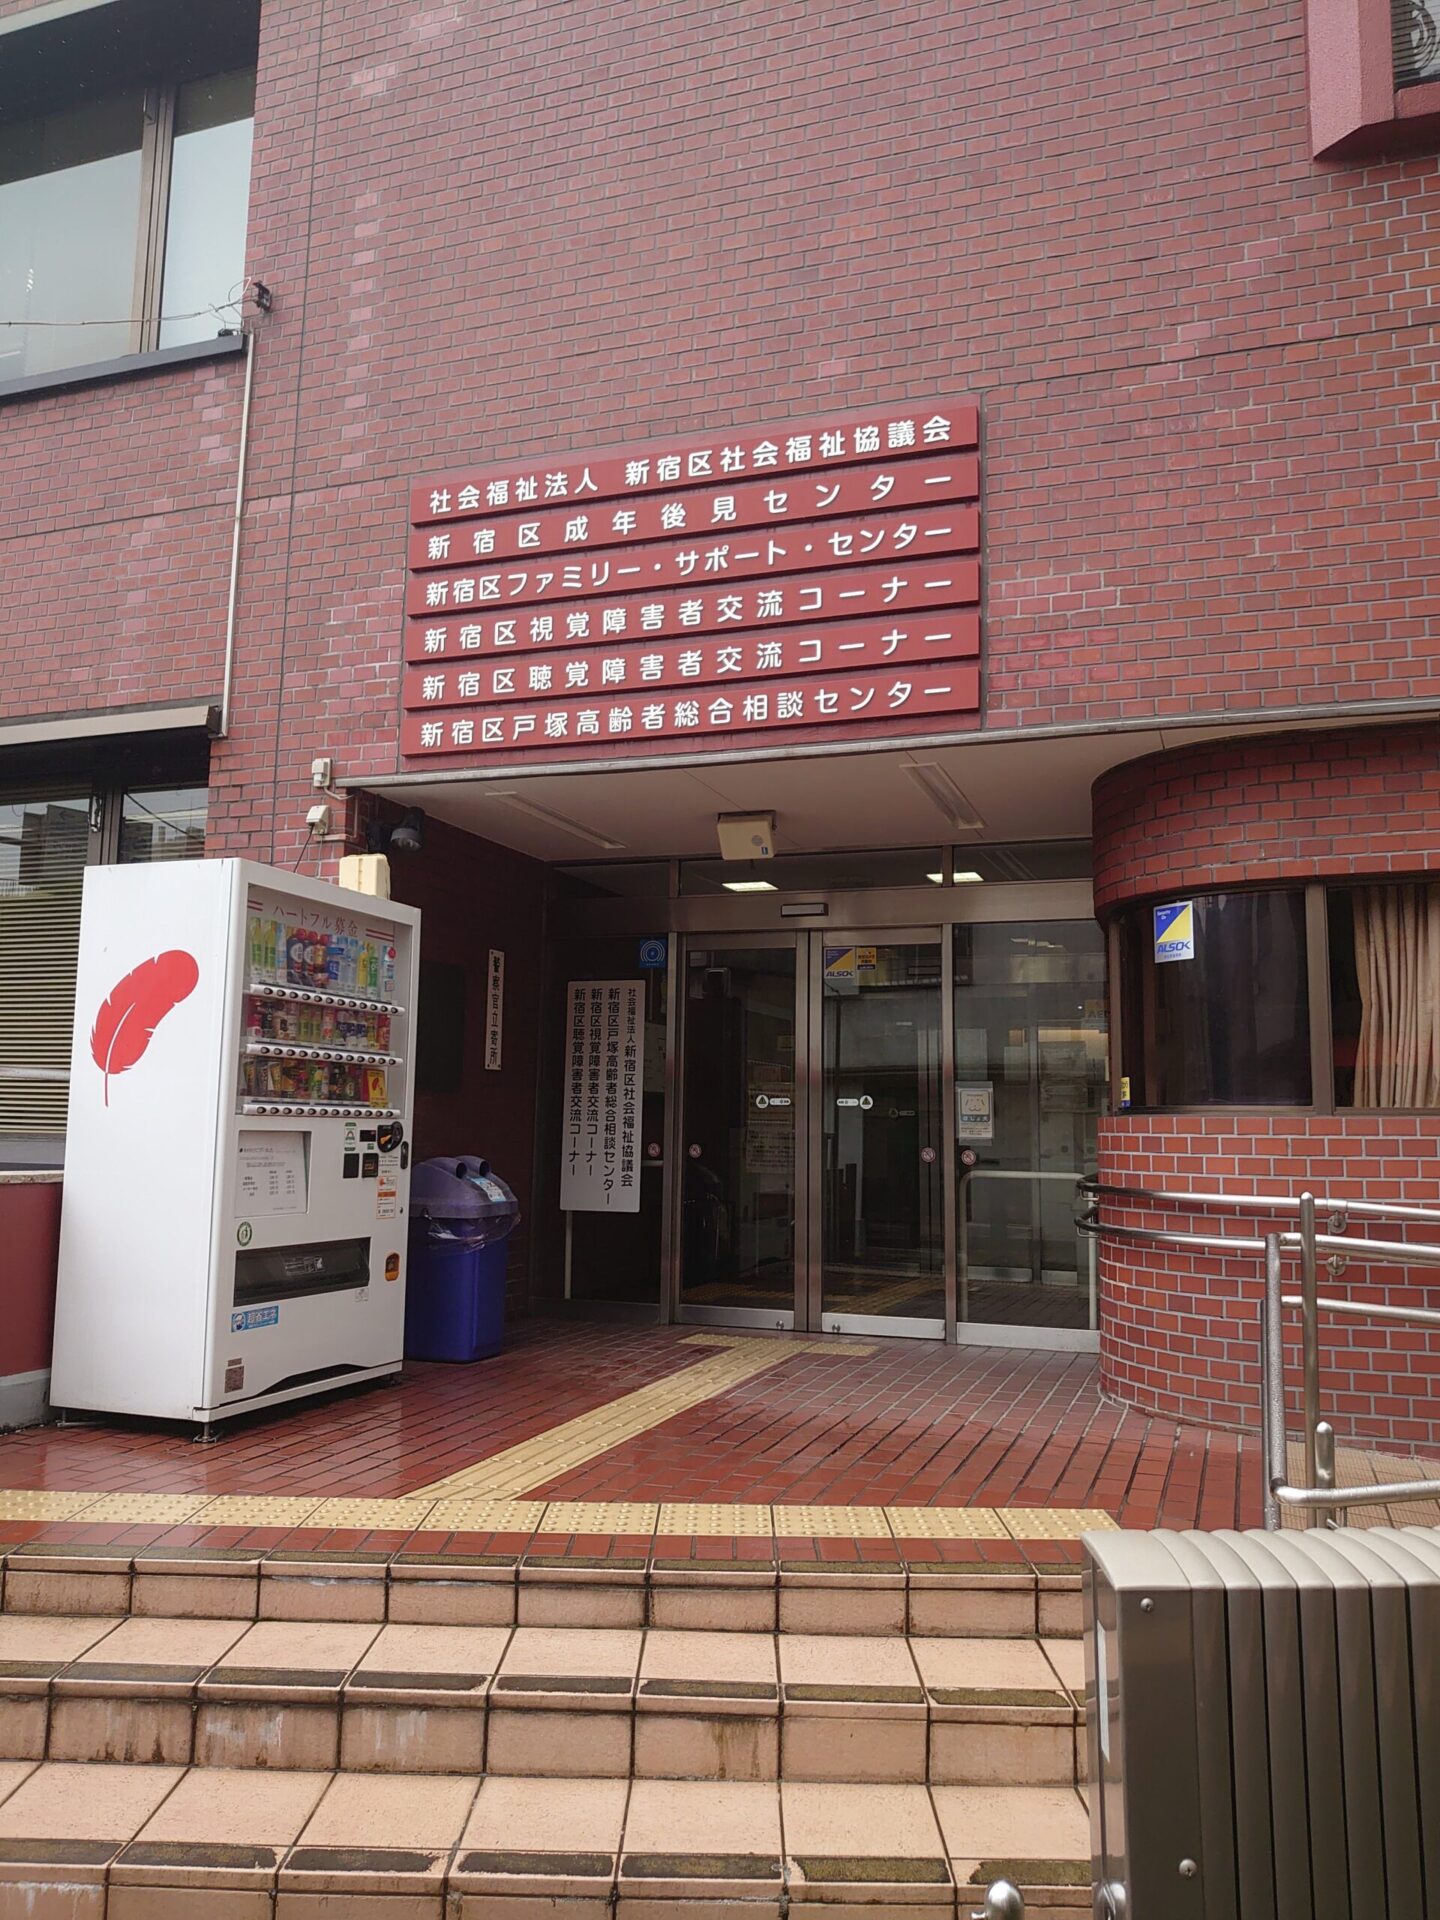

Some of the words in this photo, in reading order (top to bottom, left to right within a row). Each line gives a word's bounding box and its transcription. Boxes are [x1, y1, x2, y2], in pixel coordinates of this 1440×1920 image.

[429, 468, 598, 514] 社会福祉法人
[624, 415, 952, 487] 新宿区社会福祉協議会
[427, 474, 952, 560] 新宿区成年後見センター
[425, 522, 952, 607] 新宿区ファミリー・サポート・センター
[423, 575, 952, 654] 新宿区視覚障害者交流コーナー
[421, 628, 952, 701] 新宿区聴覚障害者交流コーナー
[420, 681, 952, 748] 新宿区戸塚高齢者総合相談センター
[1156, 940, 1191, 954] ALSOK
[568, 987, 586, 1177] 新宿区聴覚障害者交流コーナー
[585, 987, 603, 1177] 新宿区視覚障害者交流コーナー
[602, 987, 620, 1205] 新宿区戸塚高齢者総合相談センター
